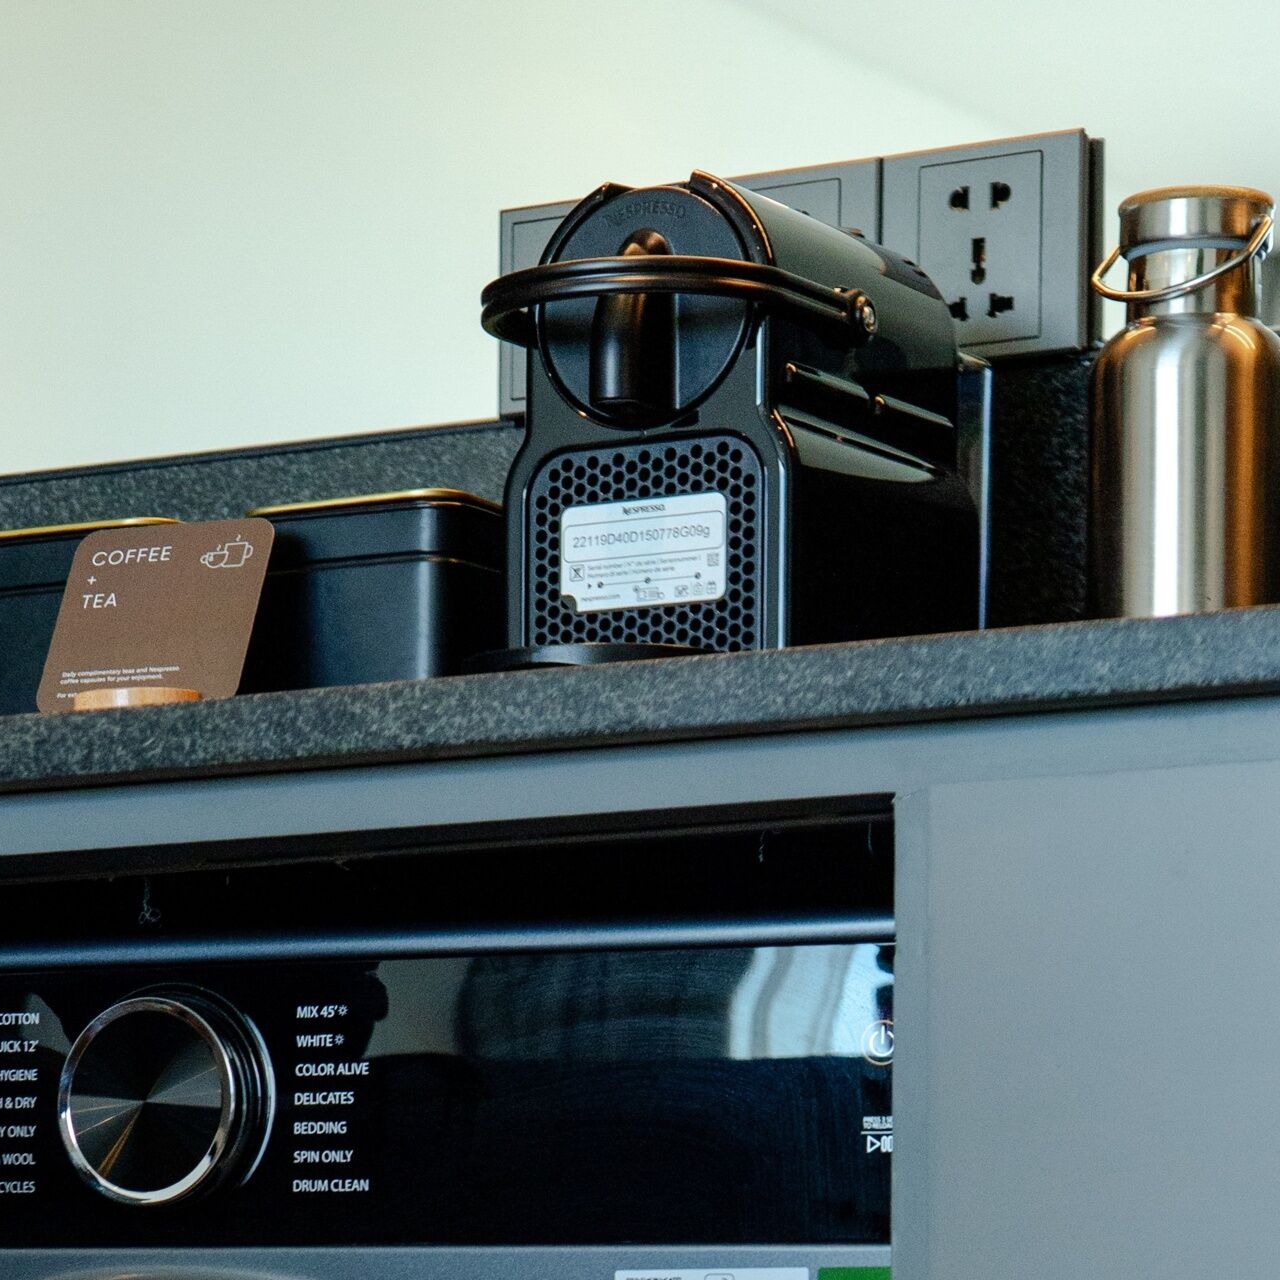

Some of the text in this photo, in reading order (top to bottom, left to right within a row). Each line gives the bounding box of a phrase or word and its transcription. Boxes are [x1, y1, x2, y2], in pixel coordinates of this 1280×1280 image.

[92, 546, 172, 566] COFFEE
[87, 576, 97, 585] +
[83, 593, 117, 608] TEA
[296, 1005, 318, 1019] MIX
[296, 1034, 333, 1048] WHITE
[295, 1062, 369, 1077] COLOR ALIVE
[5, 1096, 14, 1110] &
[15, 1096, 37, 1109] DRY
[294, 1091, 354, 1105] DELICATES
[8, 1124, 36, 1138] ONLY
[293, 1121, 348, 1135] BEDDING
[2, 1152, 36, 1166] WOOL
[293, 1149, 354, 1164] SPIN ONLY
[293, 1178, 369, 1192] DRUM CLEAN
